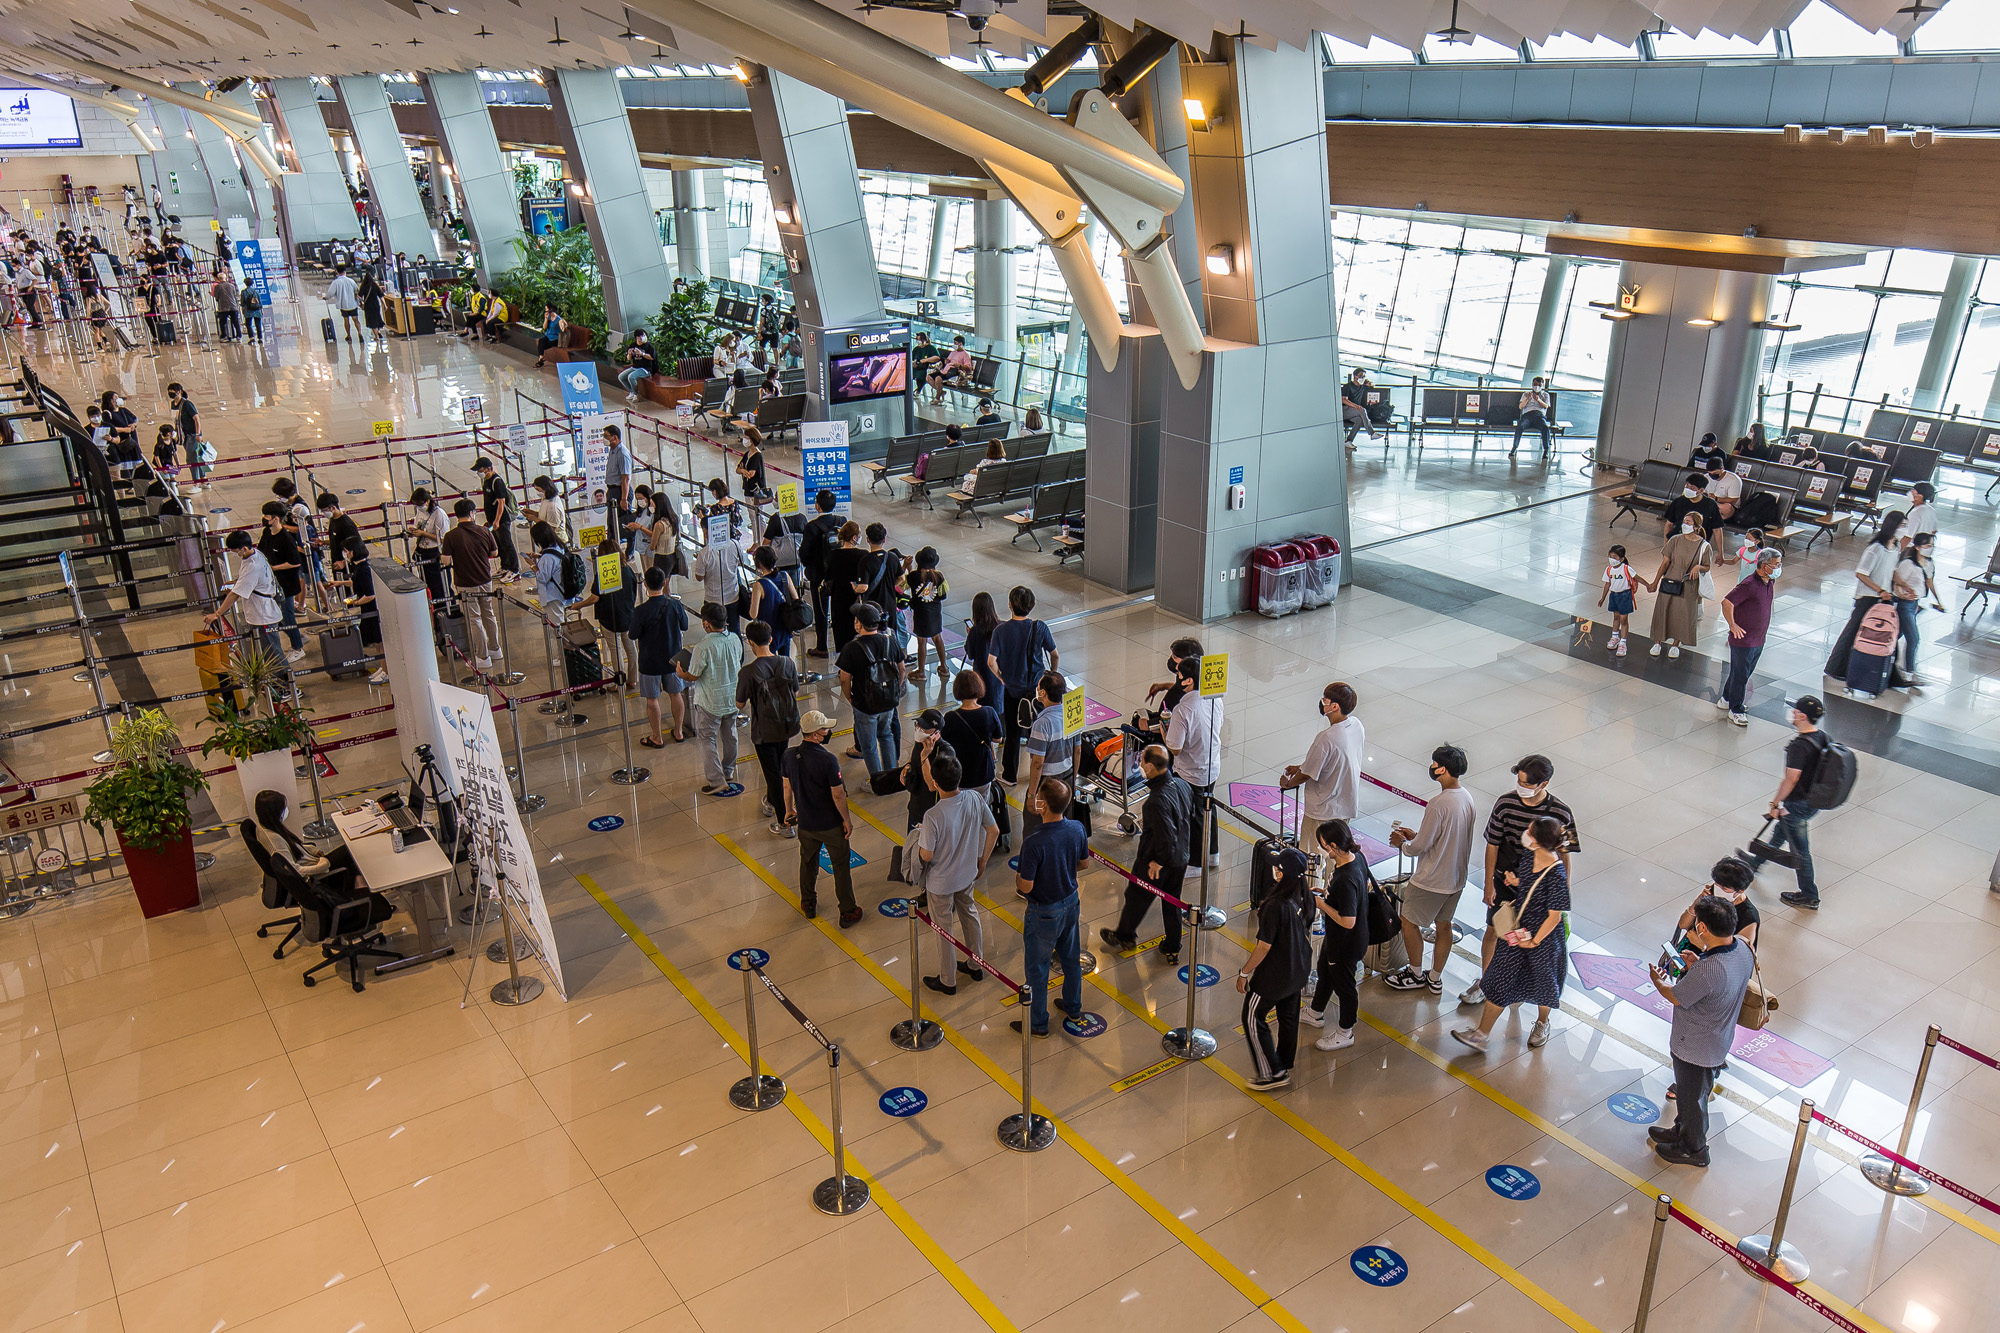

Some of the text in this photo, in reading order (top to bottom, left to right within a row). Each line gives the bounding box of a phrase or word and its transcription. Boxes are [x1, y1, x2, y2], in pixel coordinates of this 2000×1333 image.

[919, 302, 924, 313] 2
[928, 302, 934, 313] 2
[861, 334, 890, 344] QLED 8K
[864, 418, 872, 428] Q
[806, 451, 846, 463] 등록여객
[806, 464, 847, 476] 전용통로
[18, 781, 35, 790] KAC
[6, 801, 74, 829] 출입금지
[41, 855, 61, 863] KAC
[1082, 1024, 1104, 1036] 거리두기
[1736, 1032, 1776, 1058] 인천공항
[1124, 1059, 1176, 1086] Please Wait Here
[1635, 1107, 1656, 1122] 거리두기
[1824, 1117, 1881, 1151] KAC 한국공항공사
[1504, 1176, 1517, 1184] 1M
[1521, 1180, 1537, 1192] 거리두기
[1918, 1167, 1981, 1203] KAC 한국공항공사
[1701, 1228, 1757, 1270] KAC 한국공항공사
[1378, 1265, 1405, 1284] 거리두기
[1796, 1290, 1822, 1312] KAC
